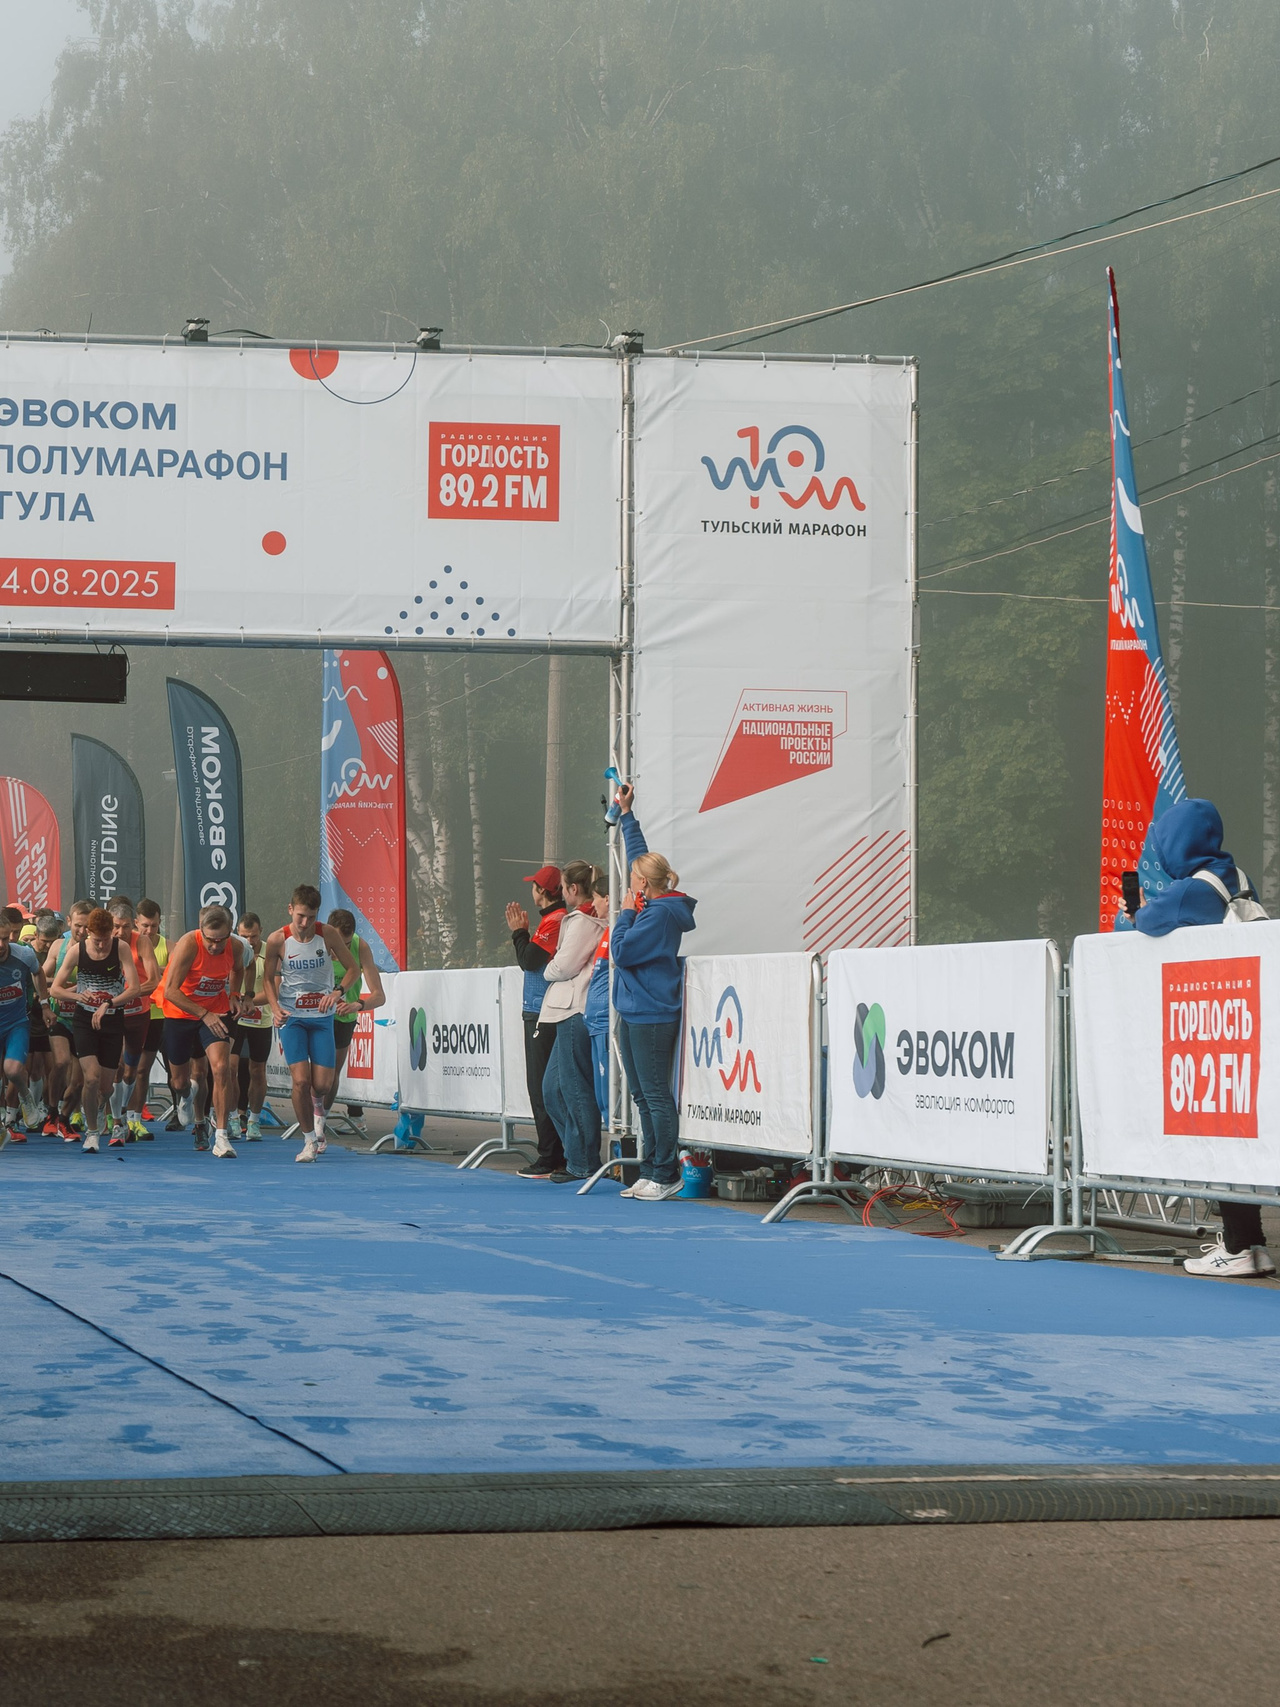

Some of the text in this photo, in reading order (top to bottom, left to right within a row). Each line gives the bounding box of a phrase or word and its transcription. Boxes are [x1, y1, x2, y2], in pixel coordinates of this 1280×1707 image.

[440, 433, 547, 442] РАДИОСТАНЦИЯ
[440, 443, 549, 469] ГОРДОСТЬ
[700, 518, 867, 537] ТУЛЬСКИЙ МАРАФОН
[741, 703, 834, 713] АКТИВНАЯ ЖИЗНЬ
[742, 721, 831, 737] НАЦИОНАЛЬНЫЕ
[780, 736, 831, 751] ПРОЕКТЫ
[789, 751, 831, 765] РОССИИ
[288, 957, 326, 970] RUSSIA
[1169, 979, 1252, 992] РАДИОСТАНЦИЯ
[1169, 998, 1253, 1041] ГОРДОСТЬ
[432, 1023, 490, 1055] ЭВОКОМ
[896, 1029, 1016, 1079] ЭВОКОМ
[687, 1102, 762, 1127] ТУЛЬСКИЙ МАРАФОН
[915, 1093, 1016, 1119] эволюция комфорта
